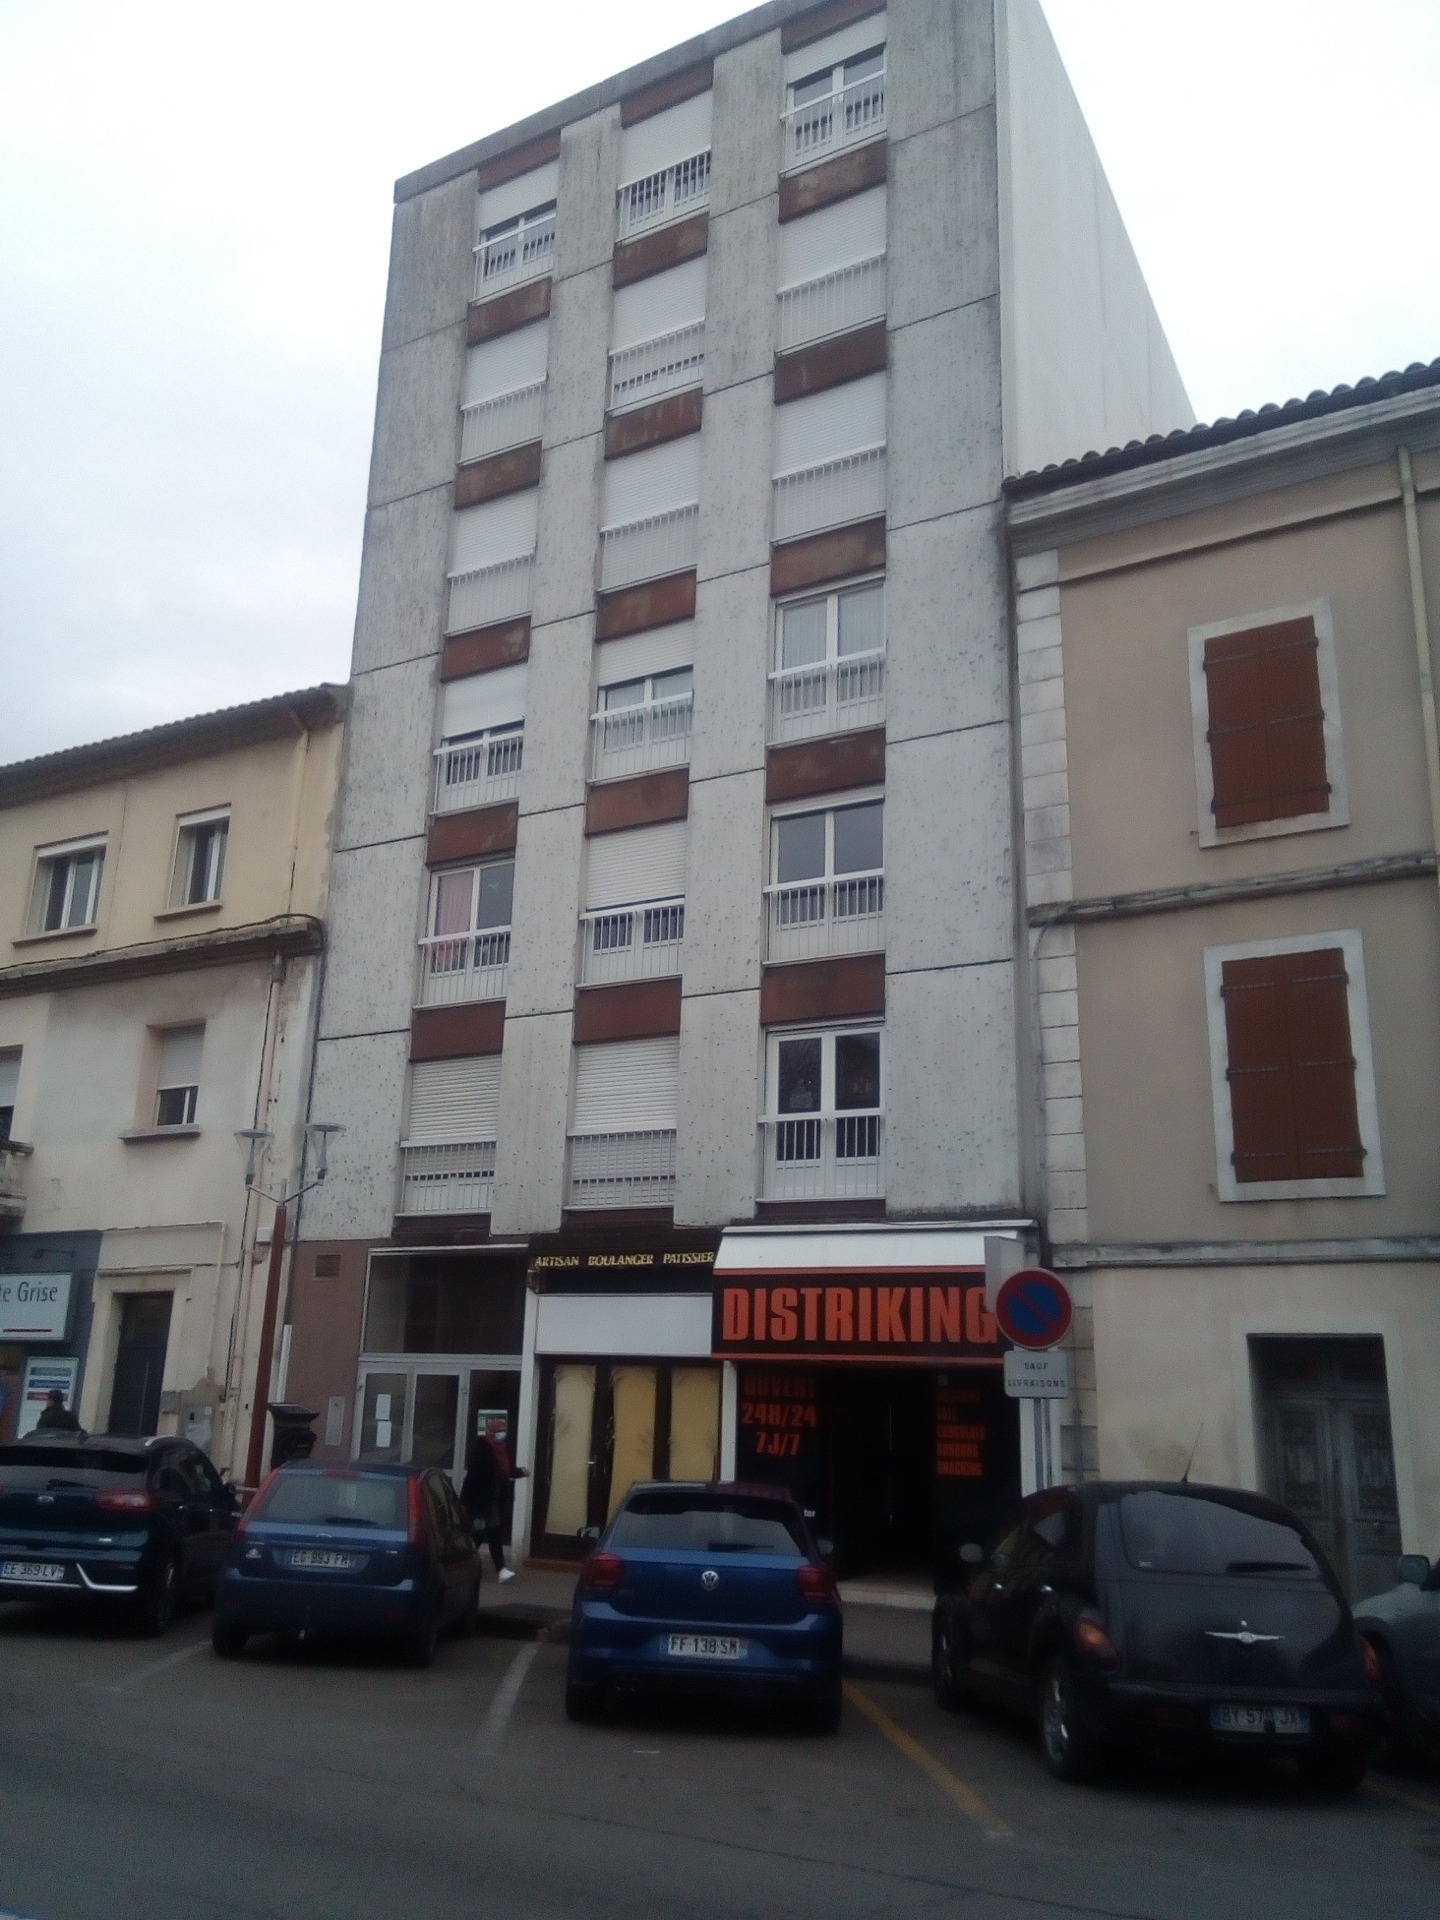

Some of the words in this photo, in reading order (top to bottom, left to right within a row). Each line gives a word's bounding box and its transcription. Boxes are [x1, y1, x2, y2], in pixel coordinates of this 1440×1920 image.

[535, 1256, 580, 1267] ARTISAN
[588, 1254, 654, 1266] BOULANGER
[663, 1251, 714, 1264] PATISSIER
[17, 1281, 58, 1302] Grise
[722, 1286, 999, 1344] DISTRIKING
[1024, 1362, 1049, 1370] SAUF
[1007, 1379, 1067, 1388] LIVRAISONS
[741, 1402, 817, 1428] 24H/24
